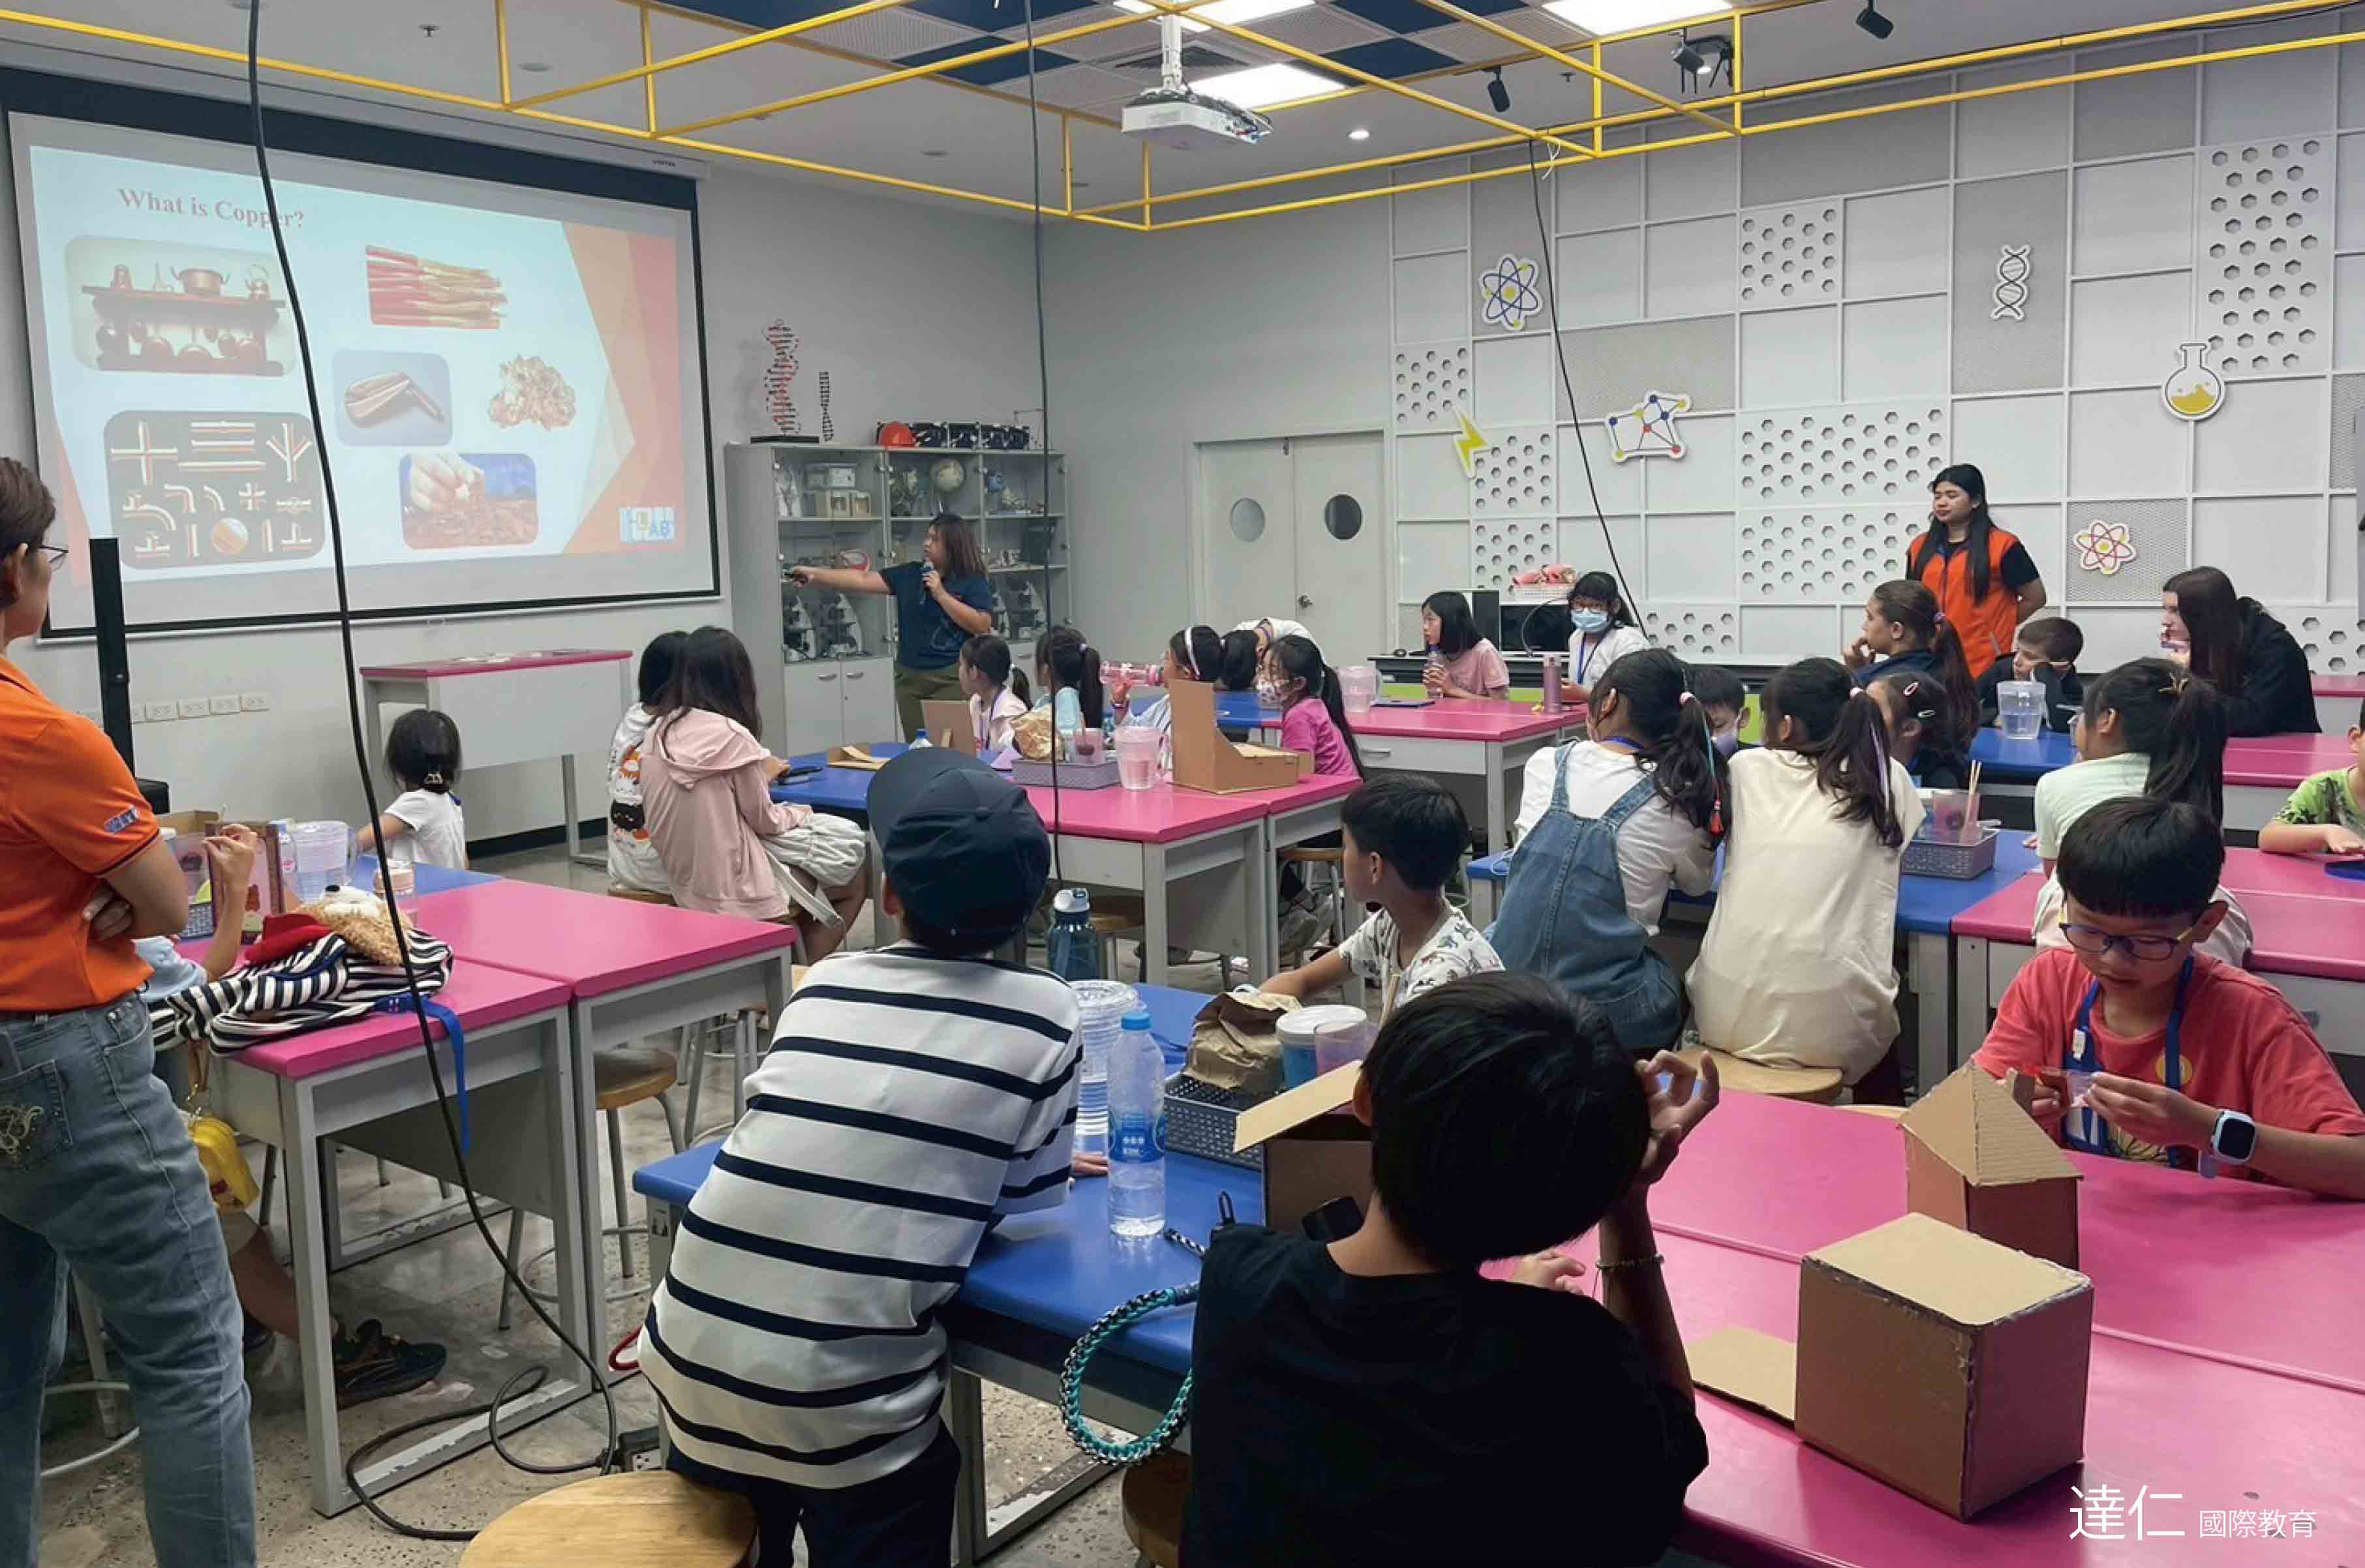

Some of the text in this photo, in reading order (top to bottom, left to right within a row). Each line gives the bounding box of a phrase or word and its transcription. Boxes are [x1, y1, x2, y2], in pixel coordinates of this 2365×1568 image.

[117, 187, 303, 229] What is Coppr?
